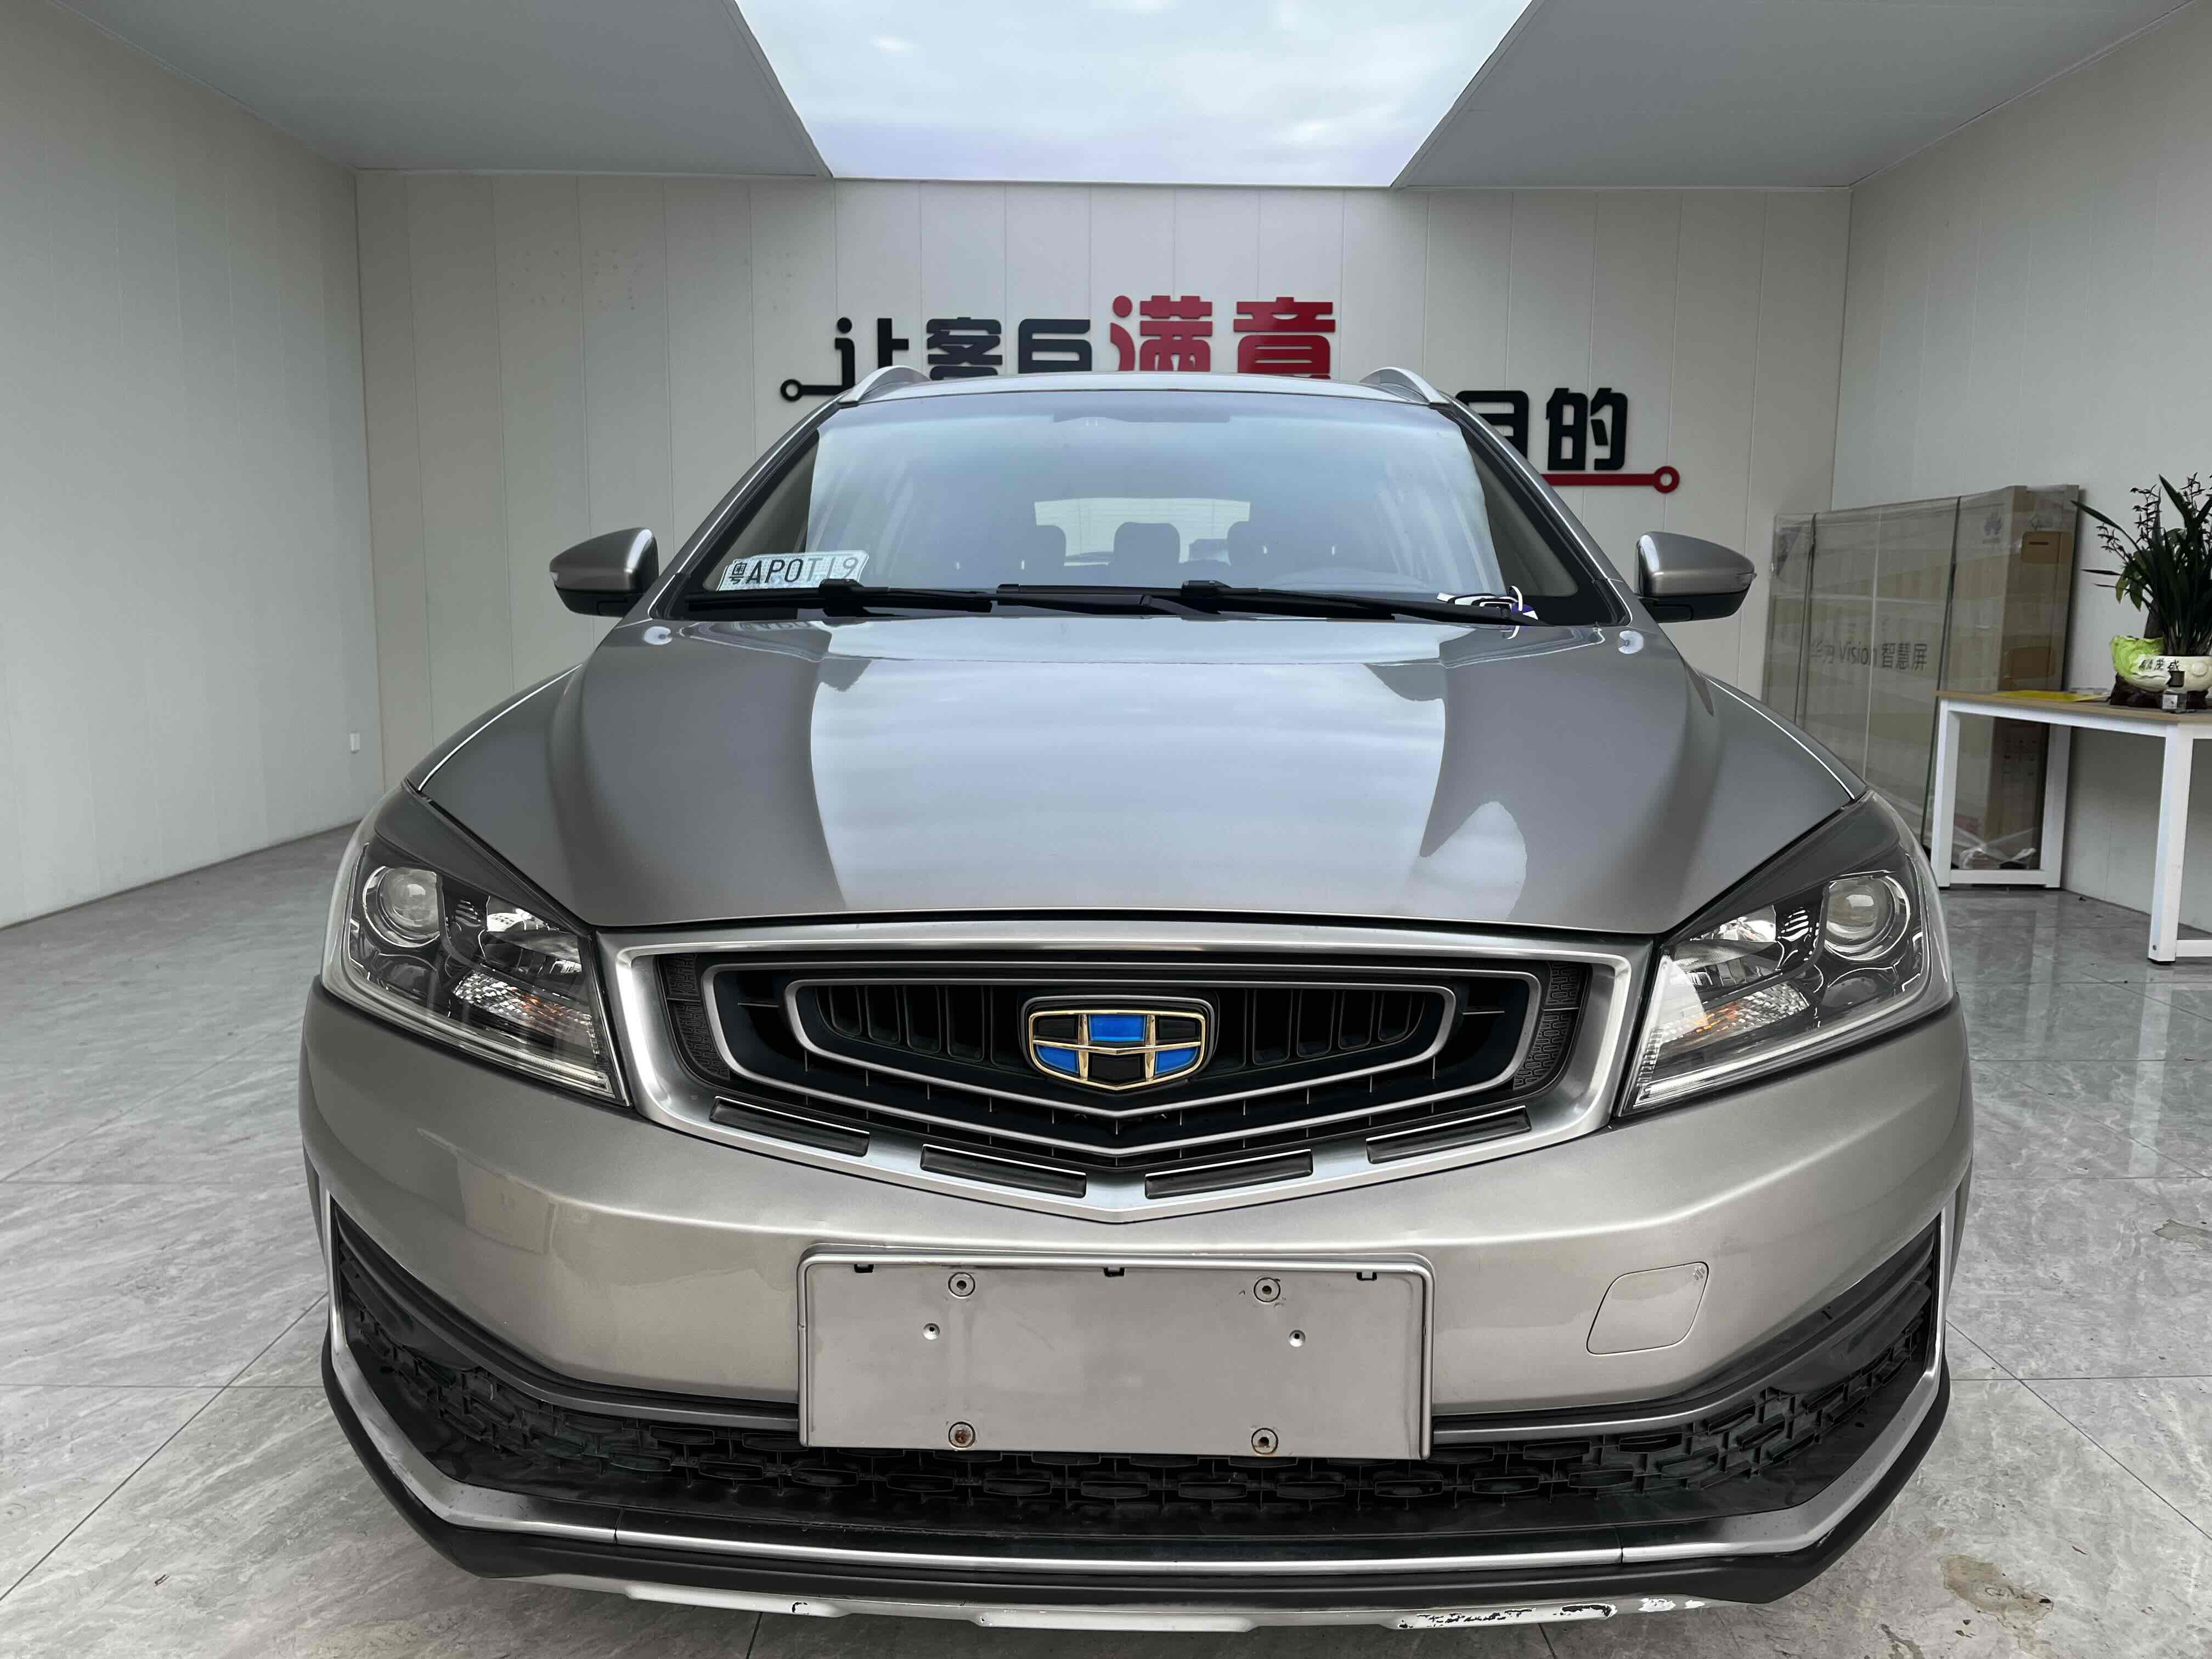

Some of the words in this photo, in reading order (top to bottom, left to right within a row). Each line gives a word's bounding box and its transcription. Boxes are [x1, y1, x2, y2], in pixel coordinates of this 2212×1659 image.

[1838, 641, 1878, 667] Vision
[1882, 642, 1927, 672] 智慧屏
